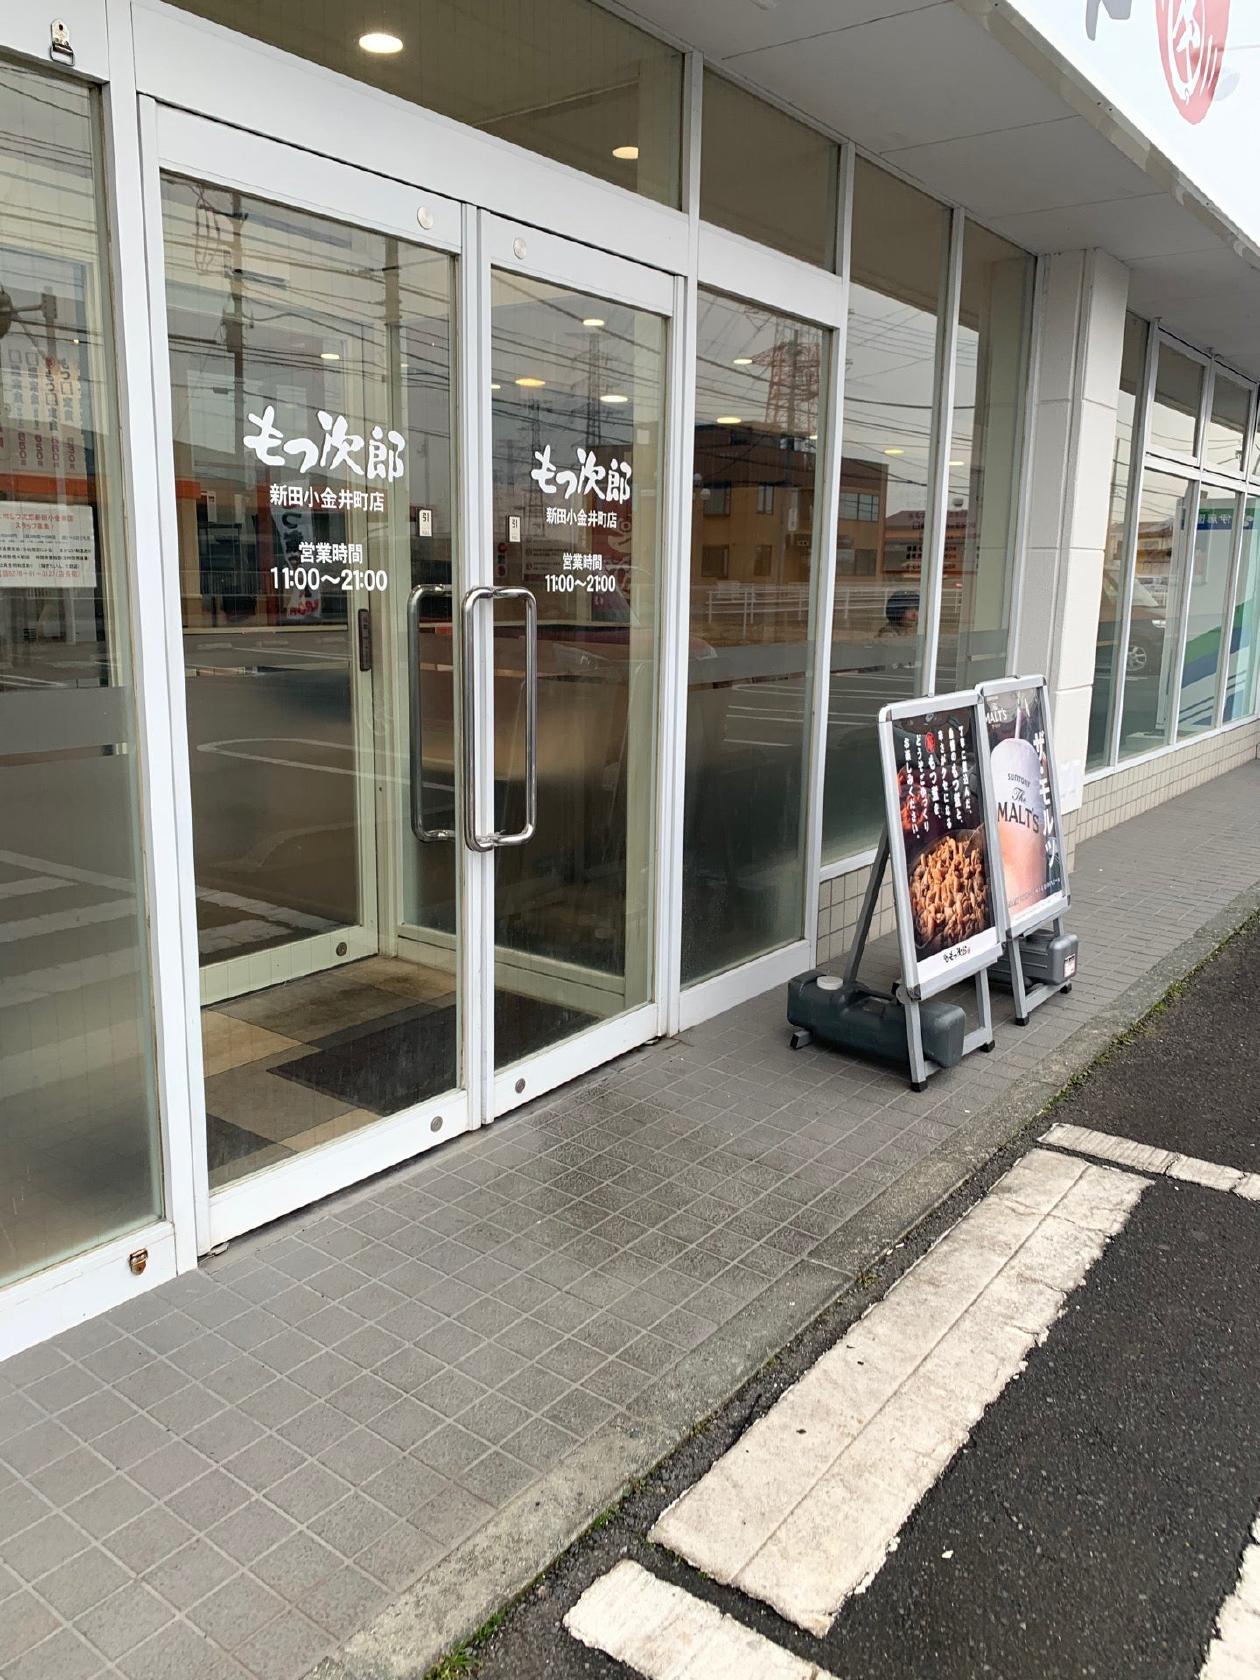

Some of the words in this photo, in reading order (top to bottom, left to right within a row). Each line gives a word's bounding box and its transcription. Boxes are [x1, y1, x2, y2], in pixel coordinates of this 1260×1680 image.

[243, 405, 406, 483] もつ次郎
[530, 444, 632, 504] もつ次郎
[269, 484, 385, 513] 新田小金井町店
[546, 507, 618, 529] 新田小金井町店
[298, 541, 363, 565] 営業時間
[562, 552, 603, 571] 営業時間
[1011, 786, 1027, 803] The
[997, 801, 1039, 833] MALT'S
